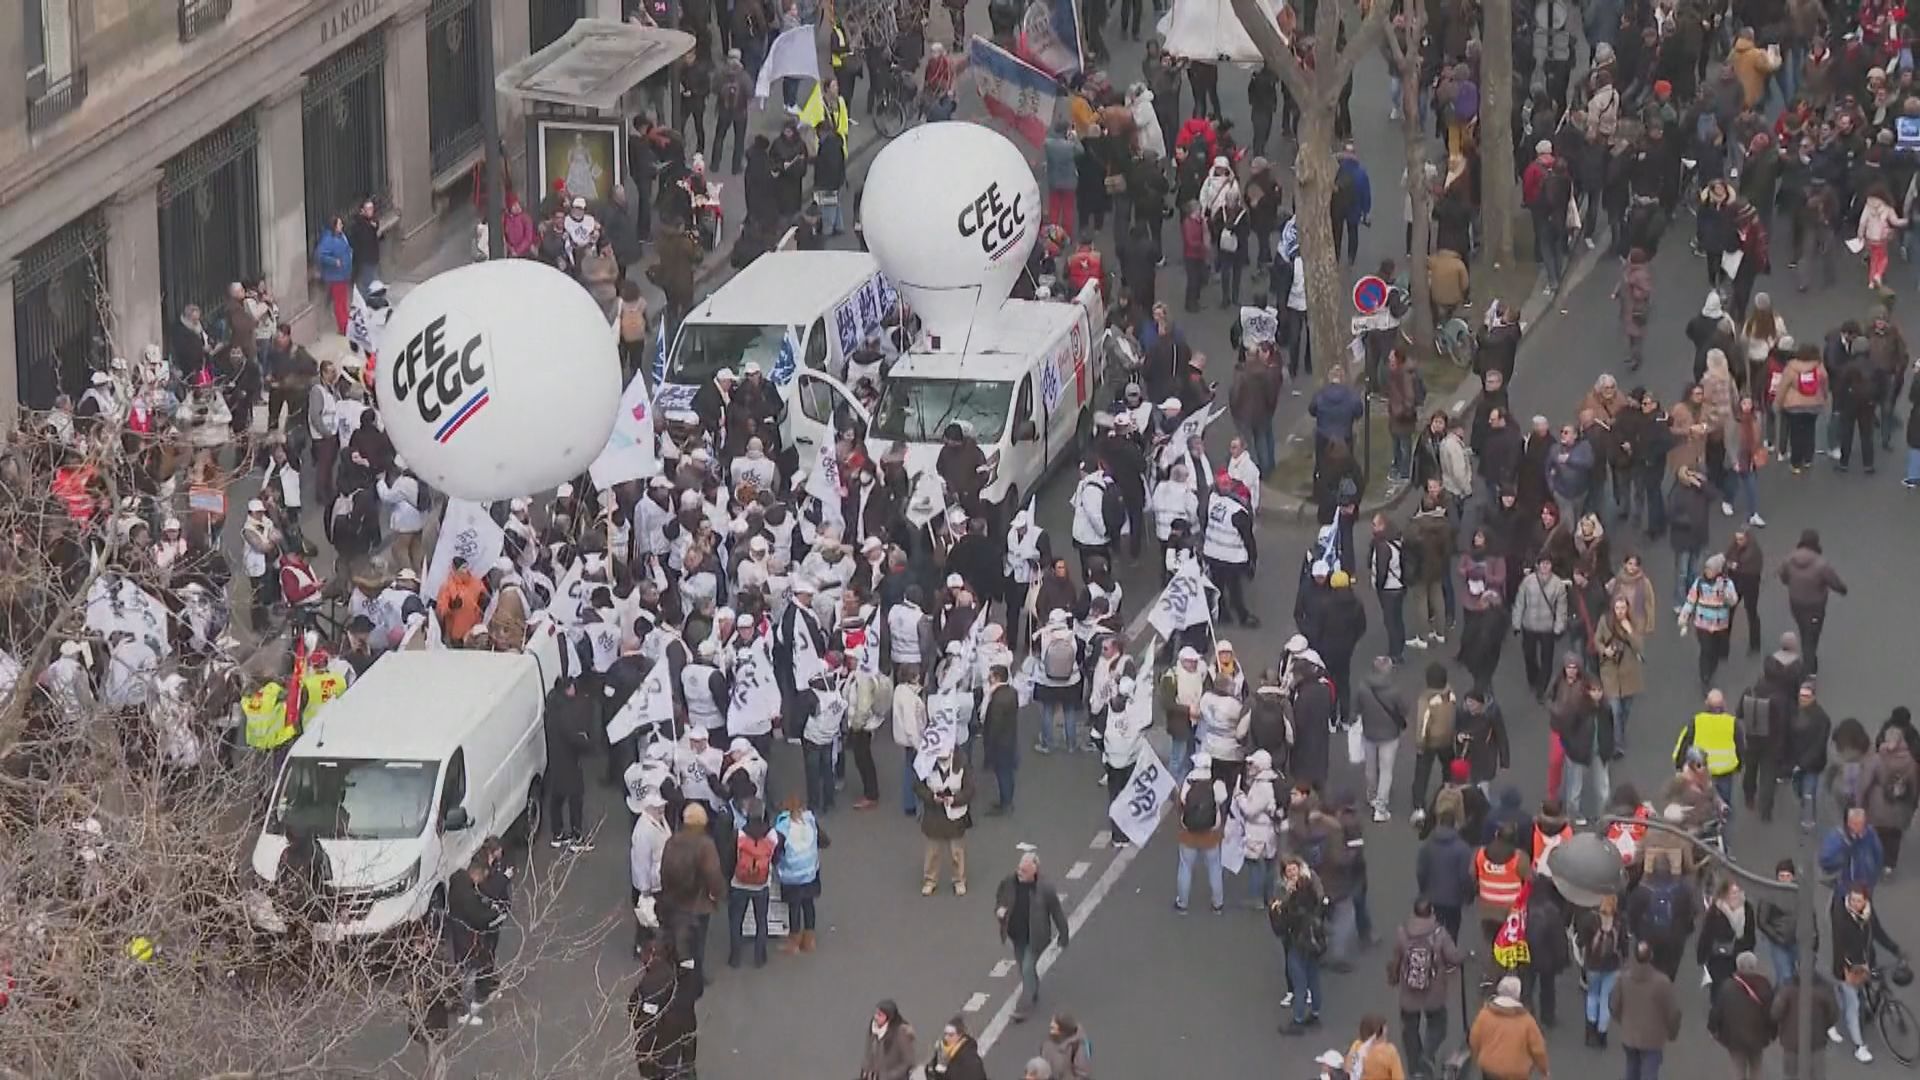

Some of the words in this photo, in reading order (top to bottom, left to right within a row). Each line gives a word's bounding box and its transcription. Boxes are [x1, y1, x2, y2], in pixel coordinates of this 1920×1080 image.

[957, 180, 1004, 237] CFE
[981, 191, 1025, 253] CGC
[393, 312, 447, 402] CFE
[417, 332, 485, 423] CGC
